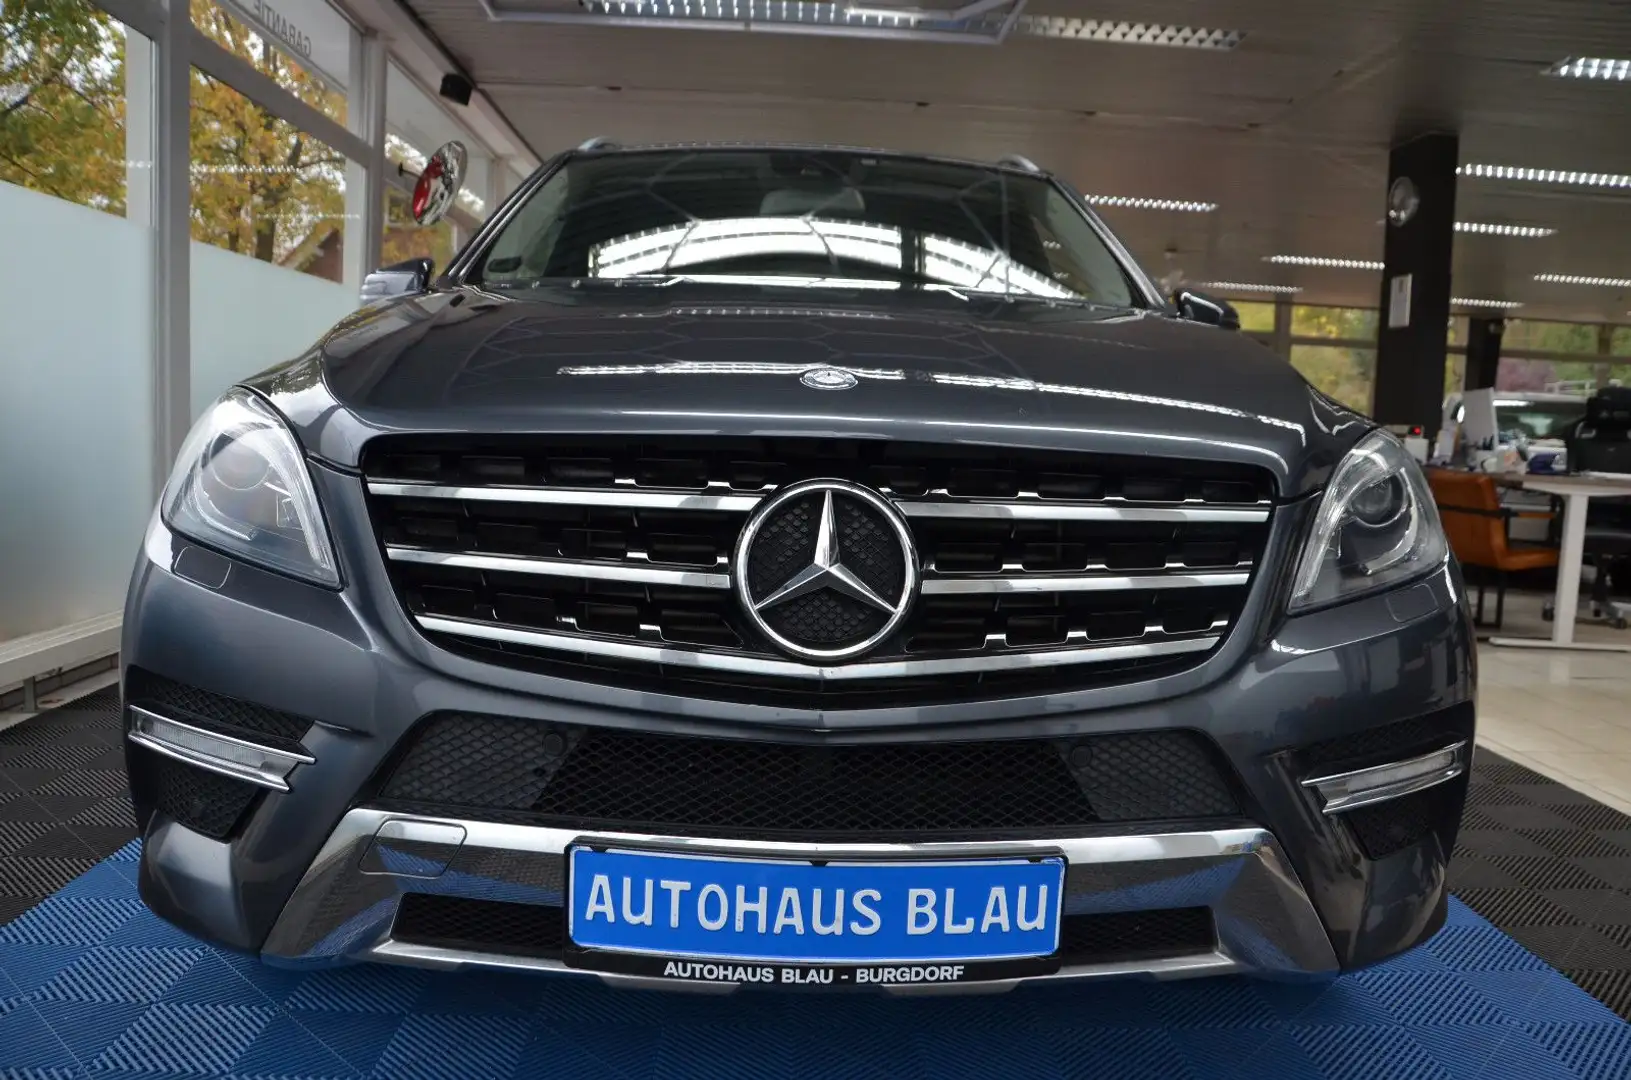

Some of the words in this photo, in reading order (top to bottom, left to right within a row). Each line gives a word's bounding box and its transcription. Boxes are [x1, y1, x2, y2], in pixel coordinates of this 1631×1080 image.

[586, 874, 881, 935] AUTOHAUS
[906, 884, 1048, 935] BLAU
[663, 961, 774, 983] AUTOHAUS
[781, 968, 834, 984] BLAU
[856, 966, 964, 983] BURGDORF
